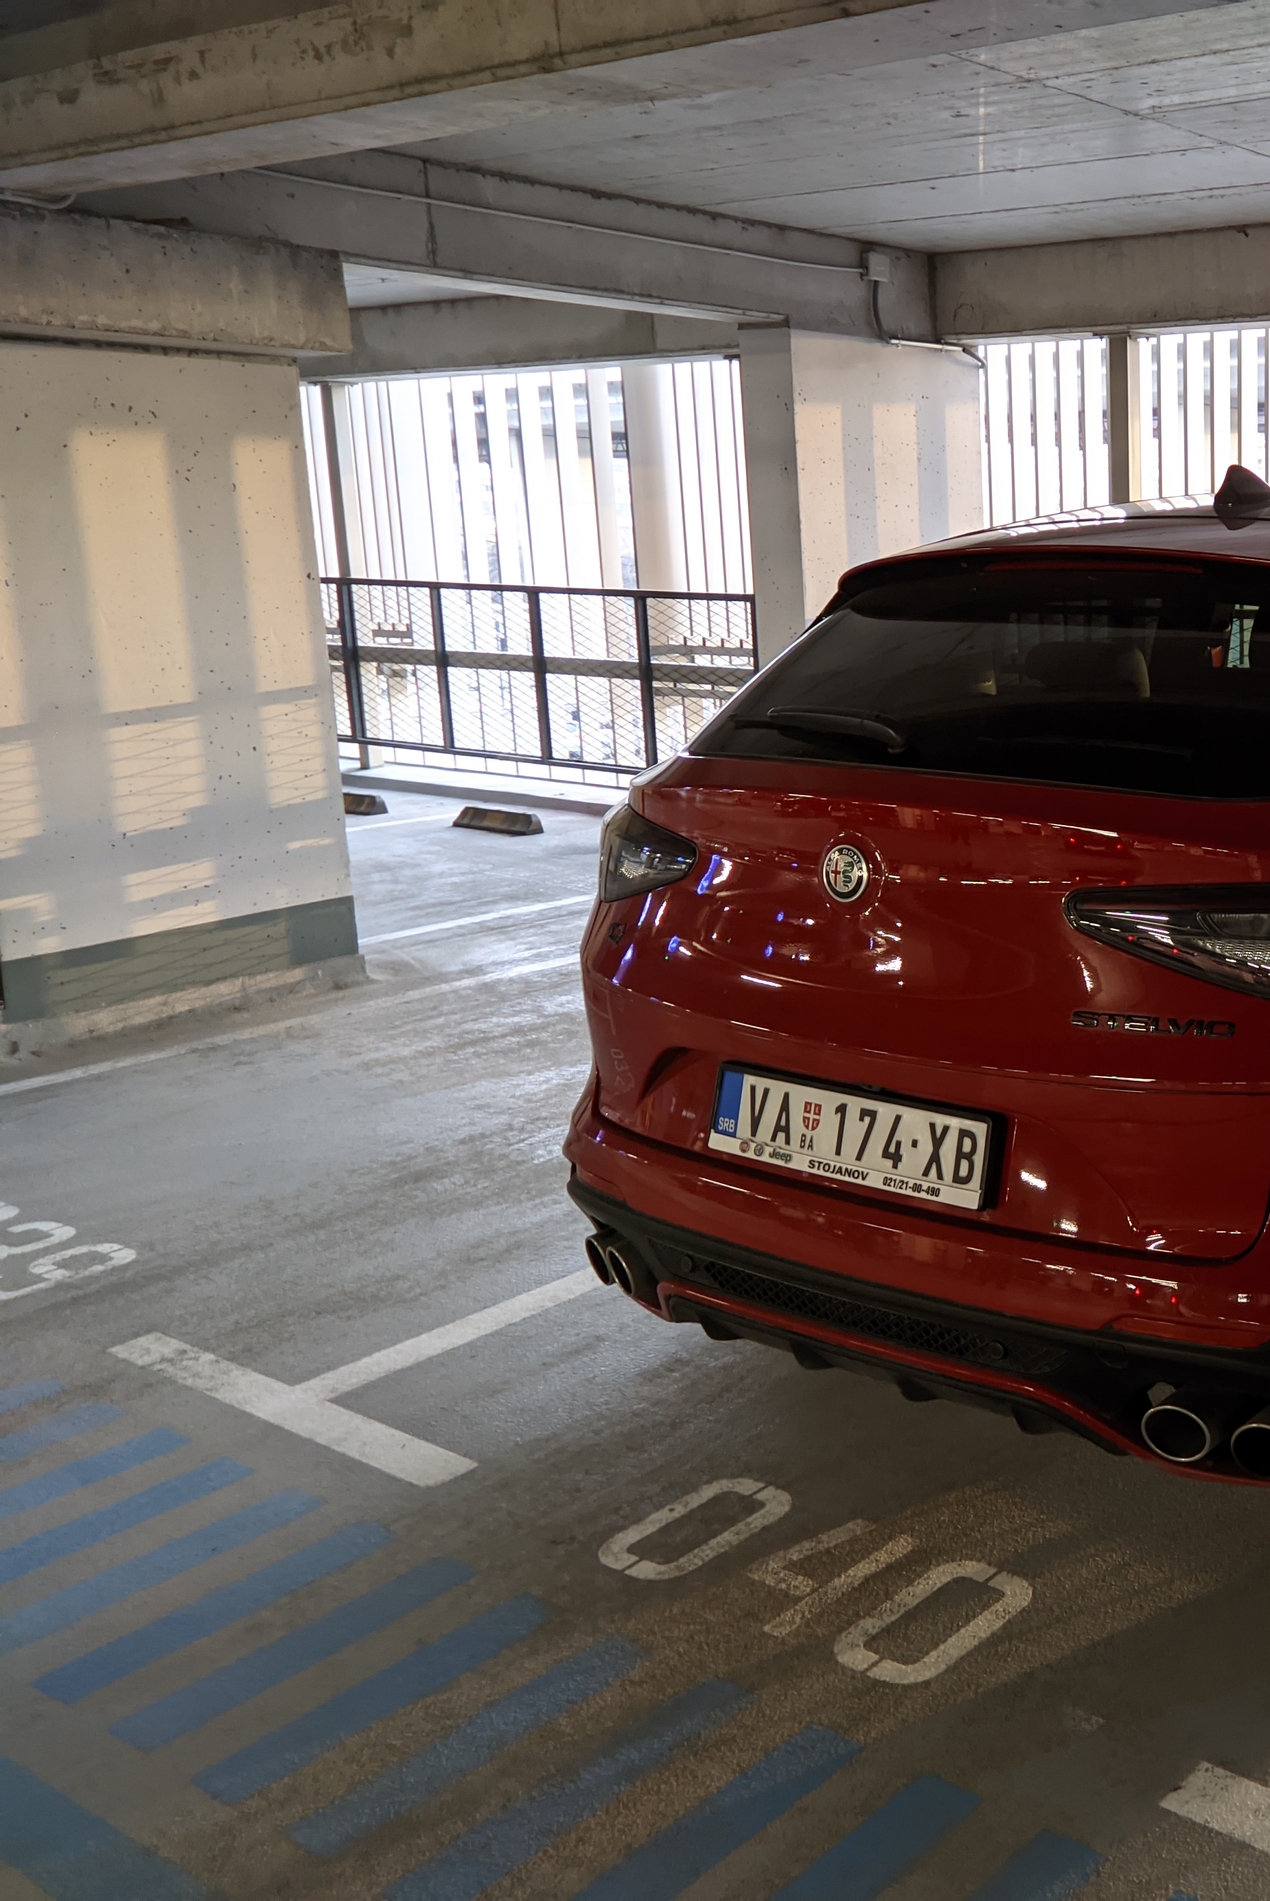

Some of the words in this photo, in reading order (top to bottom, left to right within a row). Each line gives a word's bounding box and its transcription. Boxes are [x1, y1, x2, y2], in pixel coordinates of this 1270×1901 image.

[842, 848, 864, 877] ROMEO
[1070, 1009, 1237, 1039] STELVIO
[717, 1115, 736, 1134] SRB
[749, 1083, 791, 1147] VA
[800, 1132, 815, 1152] BA
[768, 1147, 793, 1165] Jeep
[807, 1158, 870, 1182] STOJANOV
[882, 1174, 941, 1199] 021/21-00-490
